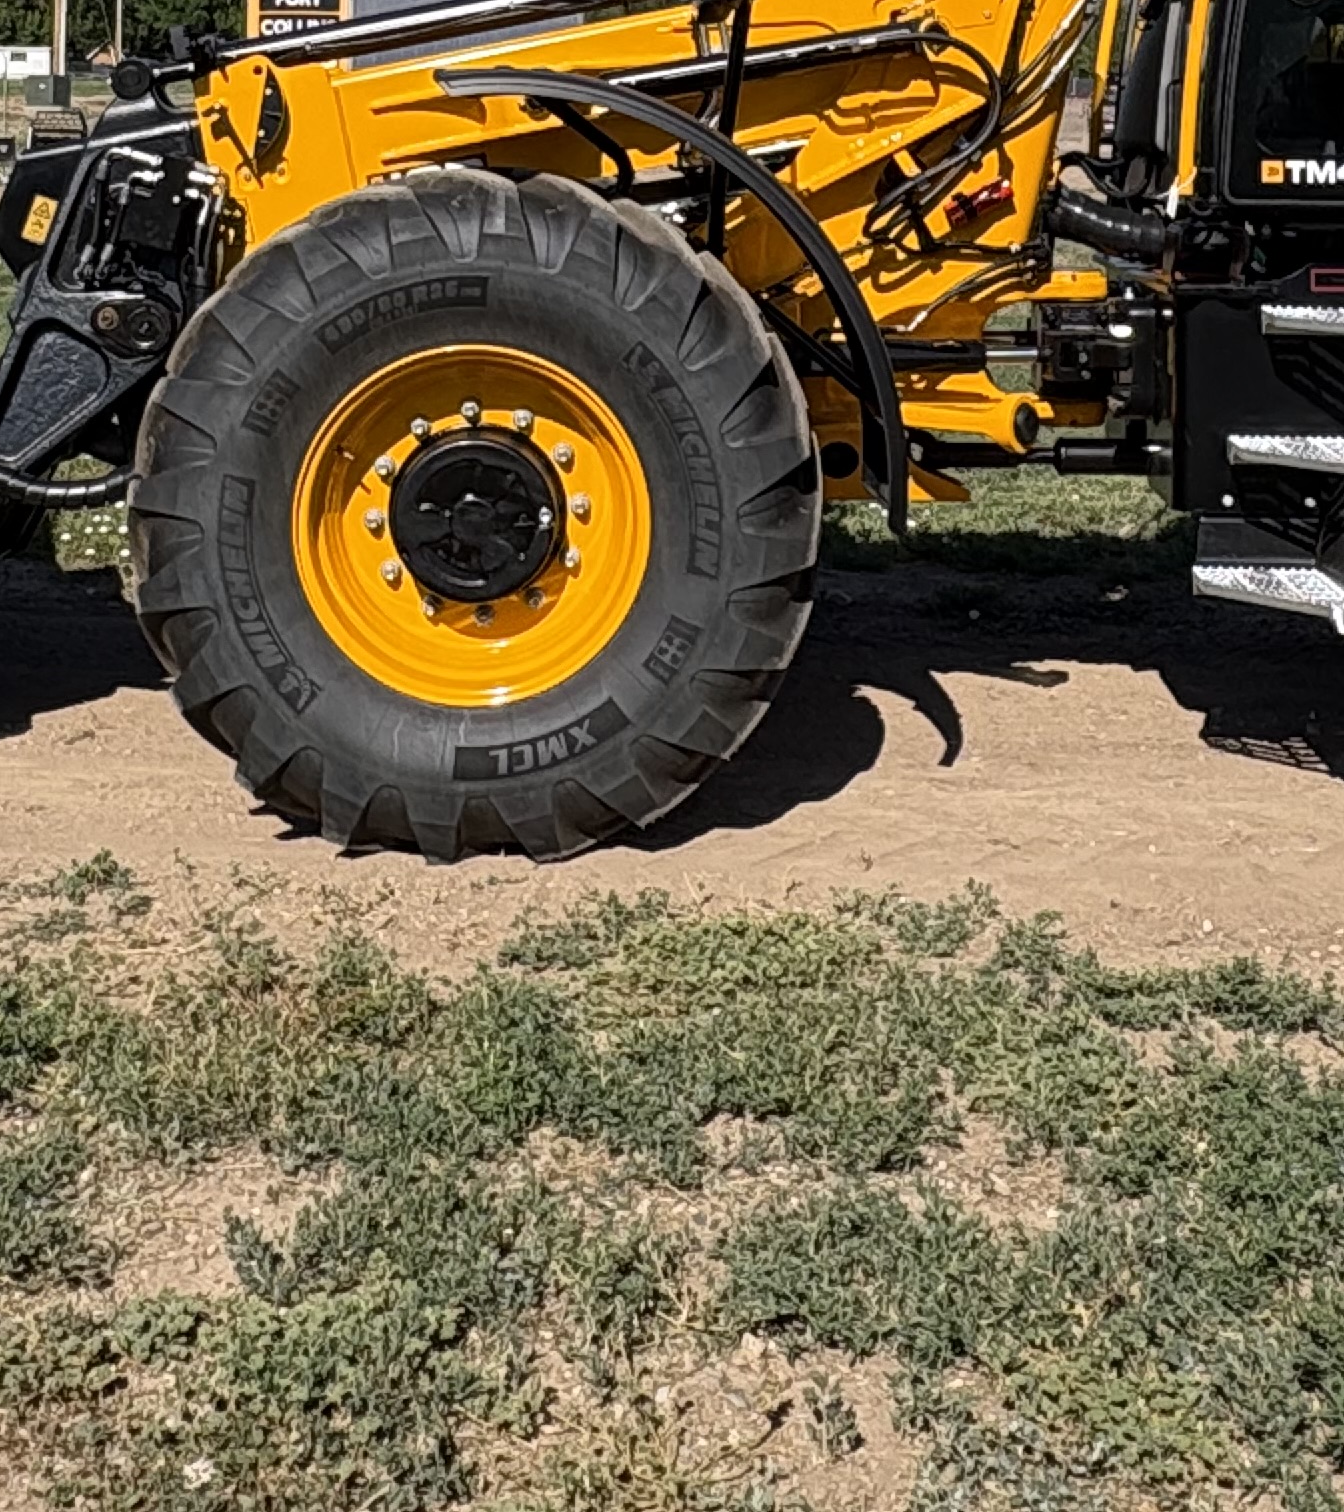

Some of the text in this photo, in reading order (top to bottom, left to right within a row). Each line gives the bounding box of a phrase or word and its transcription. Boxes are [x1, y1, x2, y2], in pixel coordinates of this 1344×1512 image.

[260, 19, 337, 36] COLLI
[657, 387, 722, 578] MICHELIN
[218, 474, 287, 670] MICHELIN
[488, 718, 598, 776] XMCL
